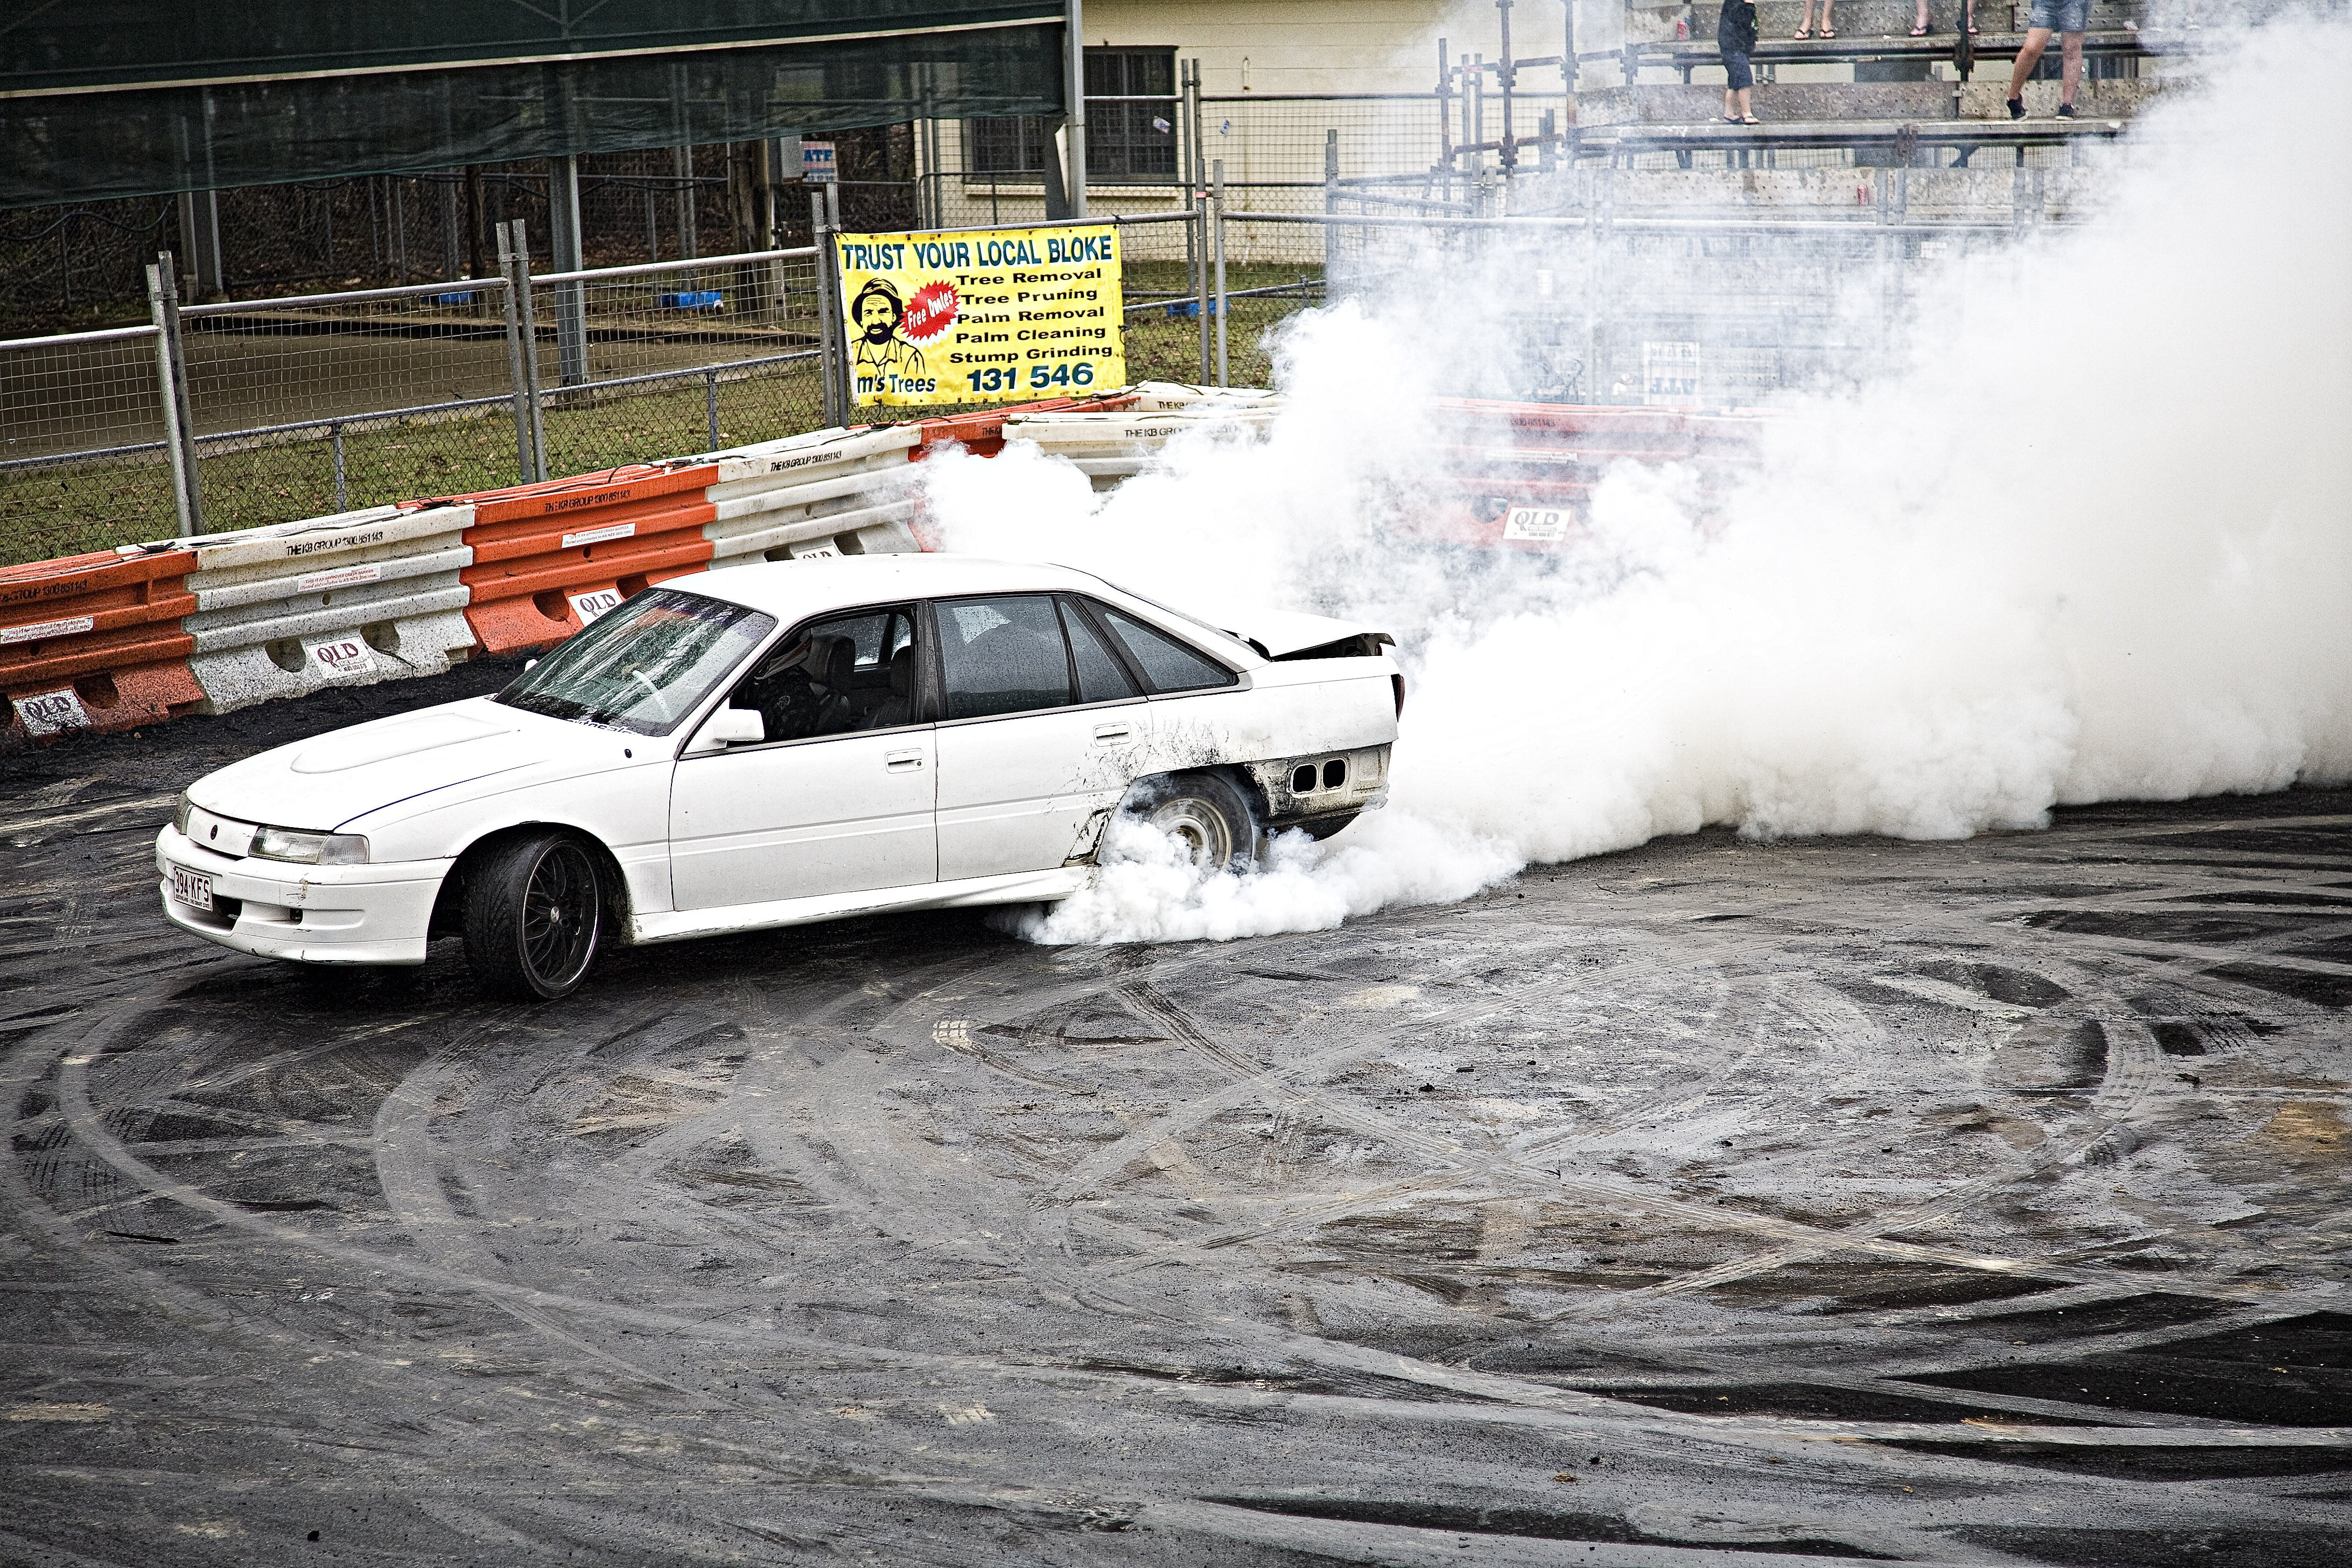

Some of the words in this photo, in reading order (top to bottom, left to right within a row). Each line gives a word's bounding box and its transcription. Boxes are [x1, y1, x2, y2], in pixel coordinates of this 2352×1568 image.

[842, 243, 905, 270] TRUST
[913, 242, 970, 269] YOUR
[977, 240, 1042, 267] LOCAL
[1047, 235, 1112, 263] BLOKE
[956, 275, 1004, 285] Tree
[1013, 268, 1101, 283] Removal
[961, 295, 1009, 305] Tree
[1018, 290, 1097, 302] Pruning
[907, 308, 927, 331] Free
[927, 290, 954, 318] Quotes
[957, 313, 1010, 324] Palm
[1019, 306, 1104, 321] Removal
[956, 332, 1009, 344] Palm
[1017, 328, 1105, 341] Cleaning
[950, 353, 1019, 363] Stump
[1026, 346, 1112, 359] Grinding
[889, 374, 936, 393] Trees
[967, 367, 1016, 391] 131
[1030, 362, 1093, 388] 546
[1158, 401, 1173, 409] THE
[1125, 429, 1143, 437] THE
[1144, 428, 1157, 437] KB
[1159, 426, 1193, 436] GRO
[771, 461, 782, 472] THE
[782, 460, 790, 470] KB
[790, 456, 811, 467] GROUP
[812, 454, 823, 464] 1300
[823, 452, 832, 461] 851
[833, 451, 842, 460] 143
[545, 501, 558, 512] THE
[558, 499, 568, 510] KB
[569, 496, 593, 508] GROUP
[594, 493, 608, 503] 1300
[608, 491, 620, 501] 851
[1515, 511, 1559, 530] QLD
[286, 544, 302, 556] THE
[302, 542, 312, 552] KB
[314, 538, 341, 551] GROUP
[342, 536, 357, 546] 1300
[372, 531, 383, 541] 143
[10, 587, 41, 601] GROUP
[75, 578, 87, 591] 143
[580, 594, 616, 617] QLD
[318, 643, 358, 668] QLD
[25, 696, 71, 722] QLD
